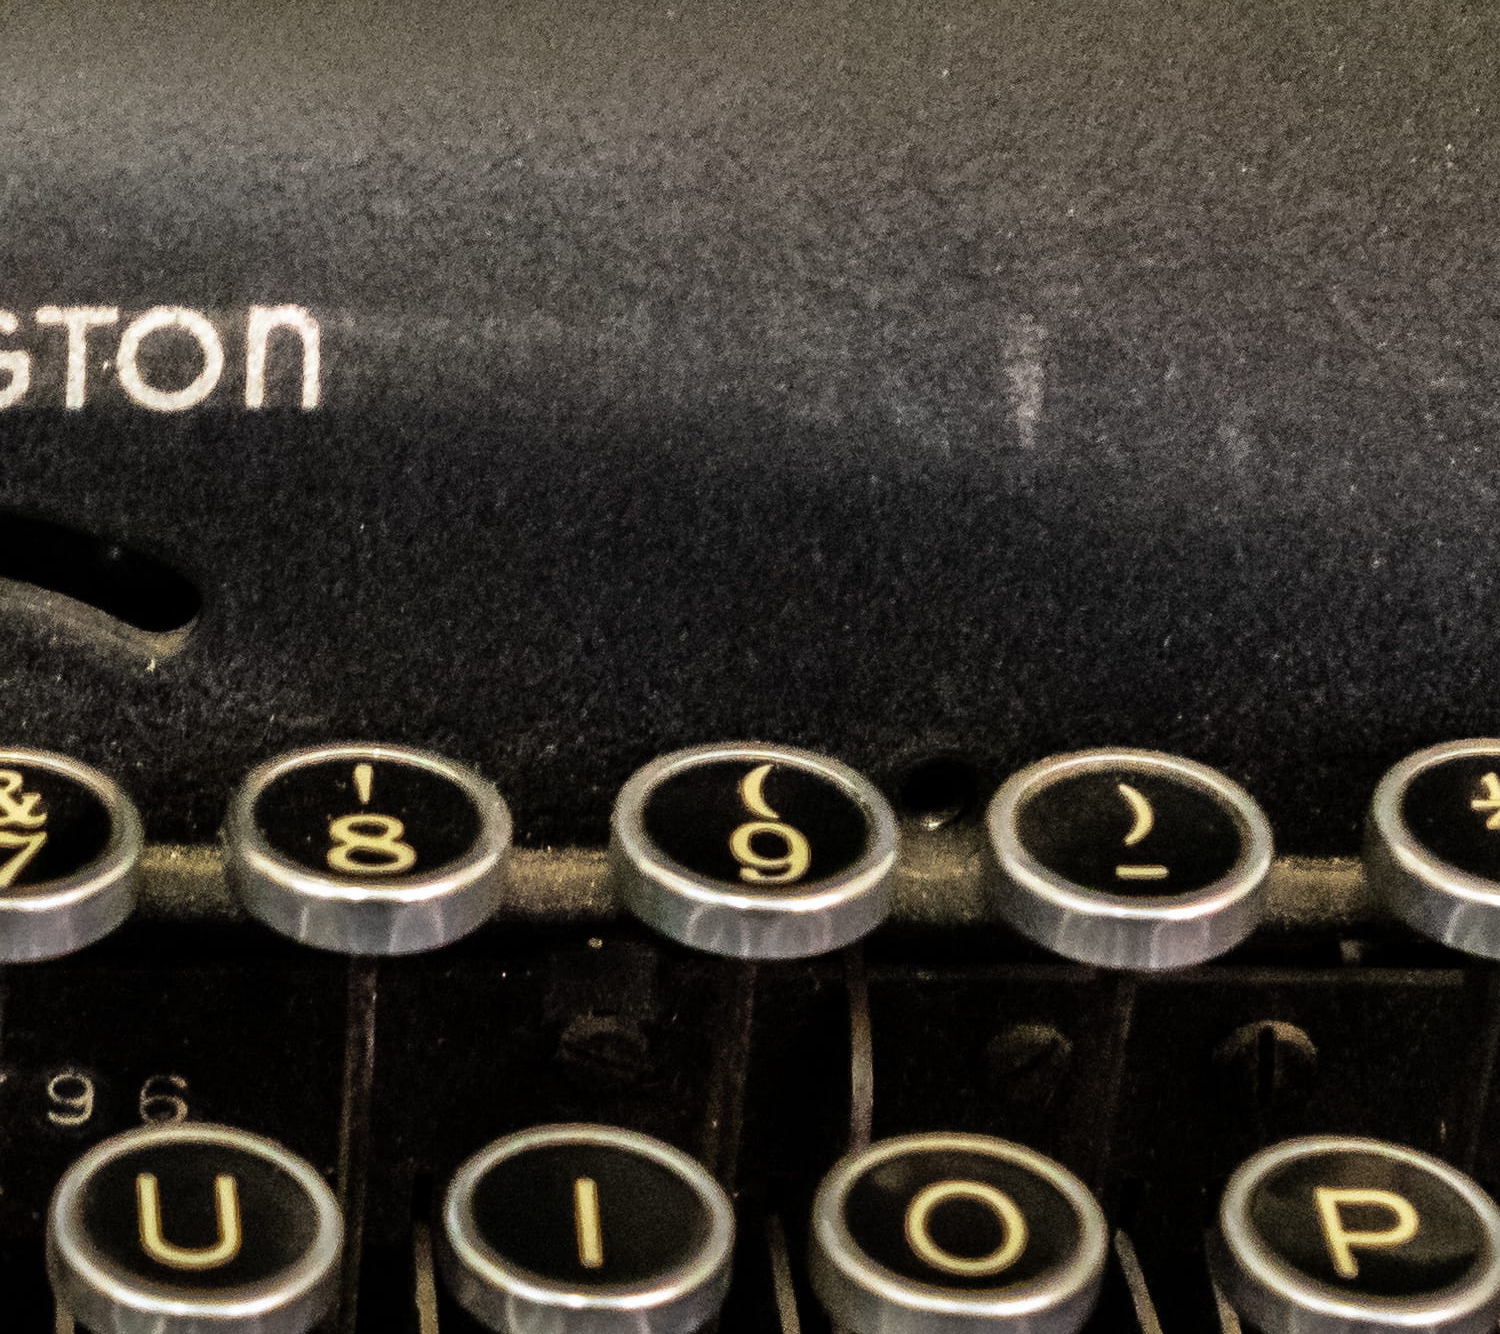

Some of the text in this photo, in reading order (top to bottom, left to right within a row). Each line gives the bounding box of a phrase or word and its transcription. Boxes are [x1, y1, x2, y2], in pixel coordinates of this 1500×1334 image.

[327, 813, 416, 873] 8
[730, 822, 813, 887] 9
[137, 1174, 241, 1268] U
[575, 1178, 602, 1265] I
[906, 1179, 1027, 1274] O
[1314, 1186, 1420, 1275] P
